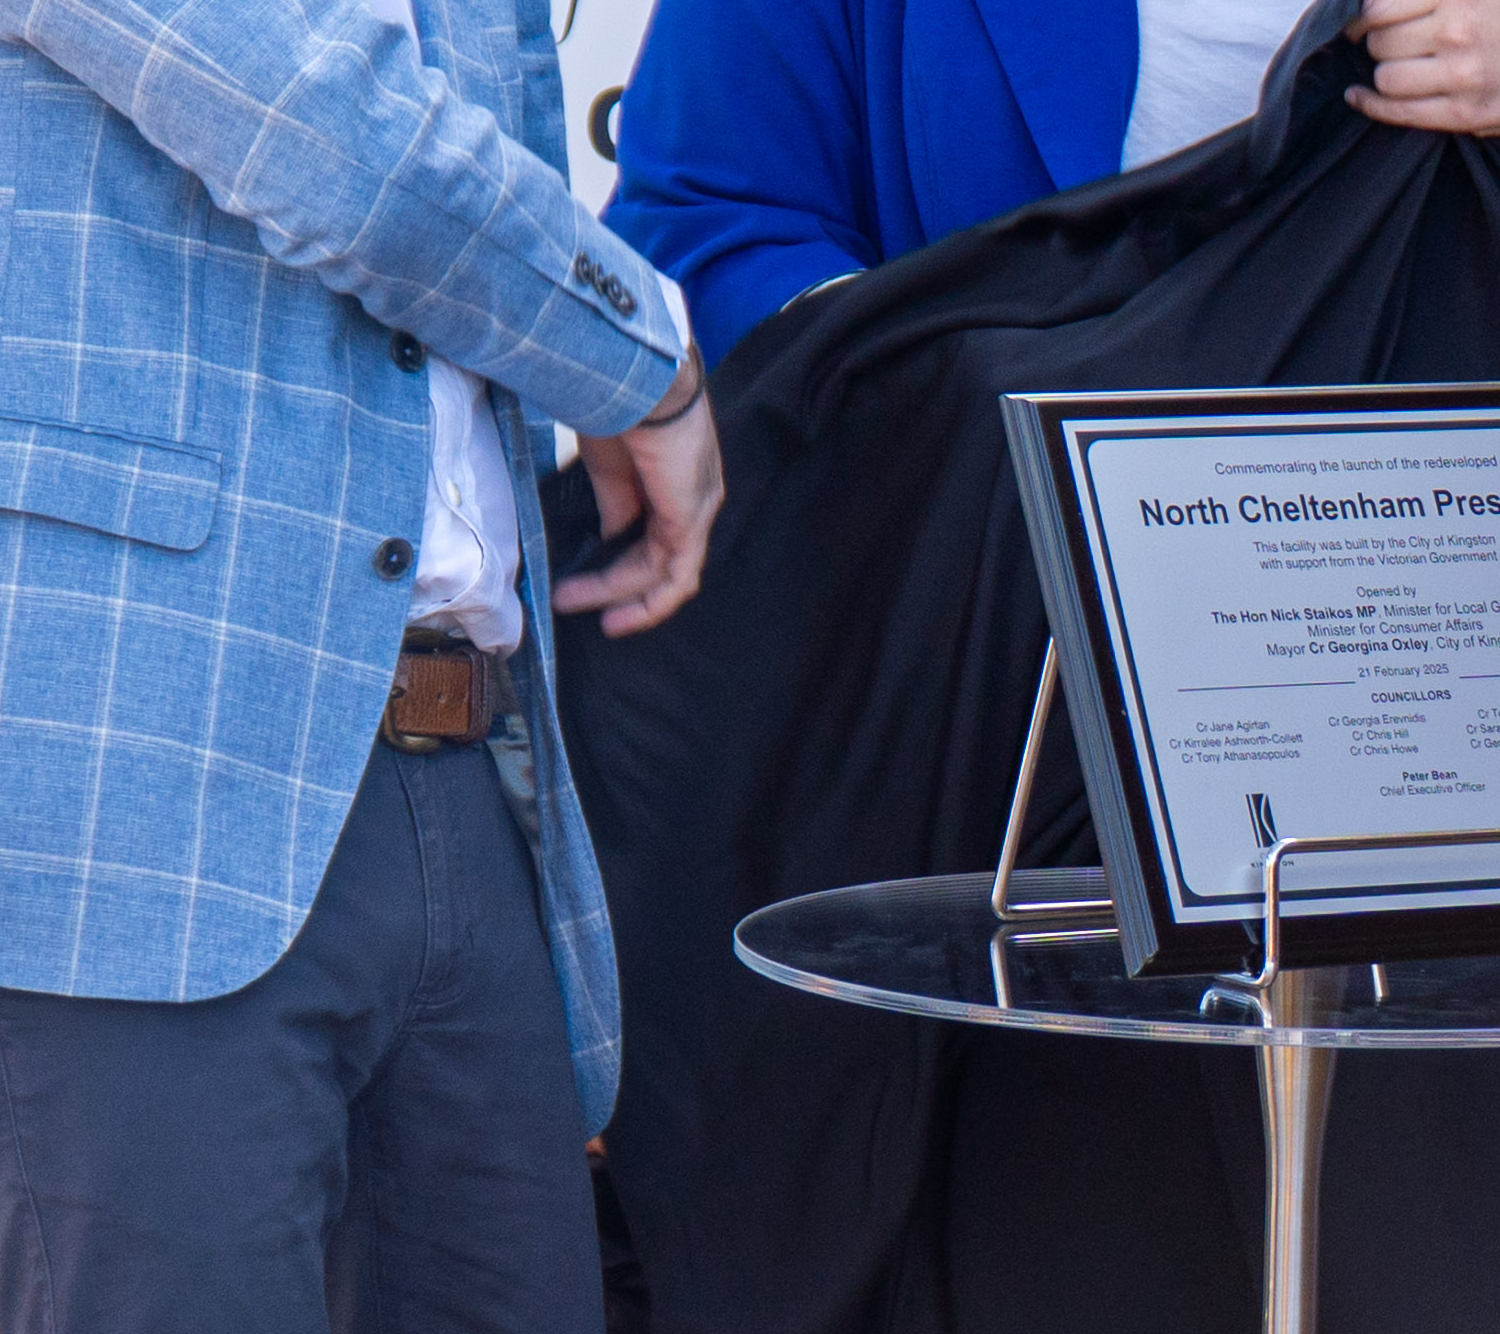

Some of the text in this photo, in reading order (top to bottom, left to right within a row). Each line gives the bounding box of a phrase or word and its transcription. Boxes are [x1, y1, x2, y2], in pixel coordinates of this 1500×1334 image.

[1214, 454, 1498, 476] Commemorating the launch of the redeveloped
[1139, 496, 1229, 527] North
[1238, 491, 1426, 524] Cheltenham
[1253, 534, 1496, 554] This facility was built by the City of Kingston
[1260, 550, 1498, 572] with support from the Victorian Government
[1356, 584, 1416, 599] Opened by
[1211, 611, 1237, 624] The
[1240, 610, 1268, 623] Hon
[1271, 608, 1301, 621] Nick
[1304, 606, 1353, 620] Staikos
[1384, 604, 1431, 617] Minister
[1435, 602, 1452, 615] for
[1456, 600, 1487, 614] Local
[1308, 618, 1484, 638] Minister for Consumer Affairs
[1266, 643, 1305, 658] Mayor
[1309, 641, 1324, 654] Cr
[1328, 639, 1389, 655] Georgina
[1436, 635, 1460, 650] City
[1463, 635, 1475, 648] of
[1357, 663, 1450, 678] 21 February 2025
[1371, 689, 1452, 704] COUNCILLORS
[1328, 716, 1340, 727] Cr
[1342, 715, 1380, 728] Georgia
[1477, 709, 1489, 719] Cr
[1196, 722, 1208, 732] Cr
[1210, 721, 1234, 732] Jane
[1466, 724, 1478, 735] Cr
[1352, 730, 1364, 741] Cr
[1366, 729, 1392, 740] Chris
[1169, 738, 1181, 749] Cr
[1350, 744, 1419, 756] Cr Chris Howe
[1470, 738, 1482, 749] Cr
[1181, 753, 1194, 764] Cr
[1196, 752, 1221, 764] Tony
[1402, 770, 1458, 782] Peter Bean
[1380, 782, 1486, 797] Chief Executive Officer
